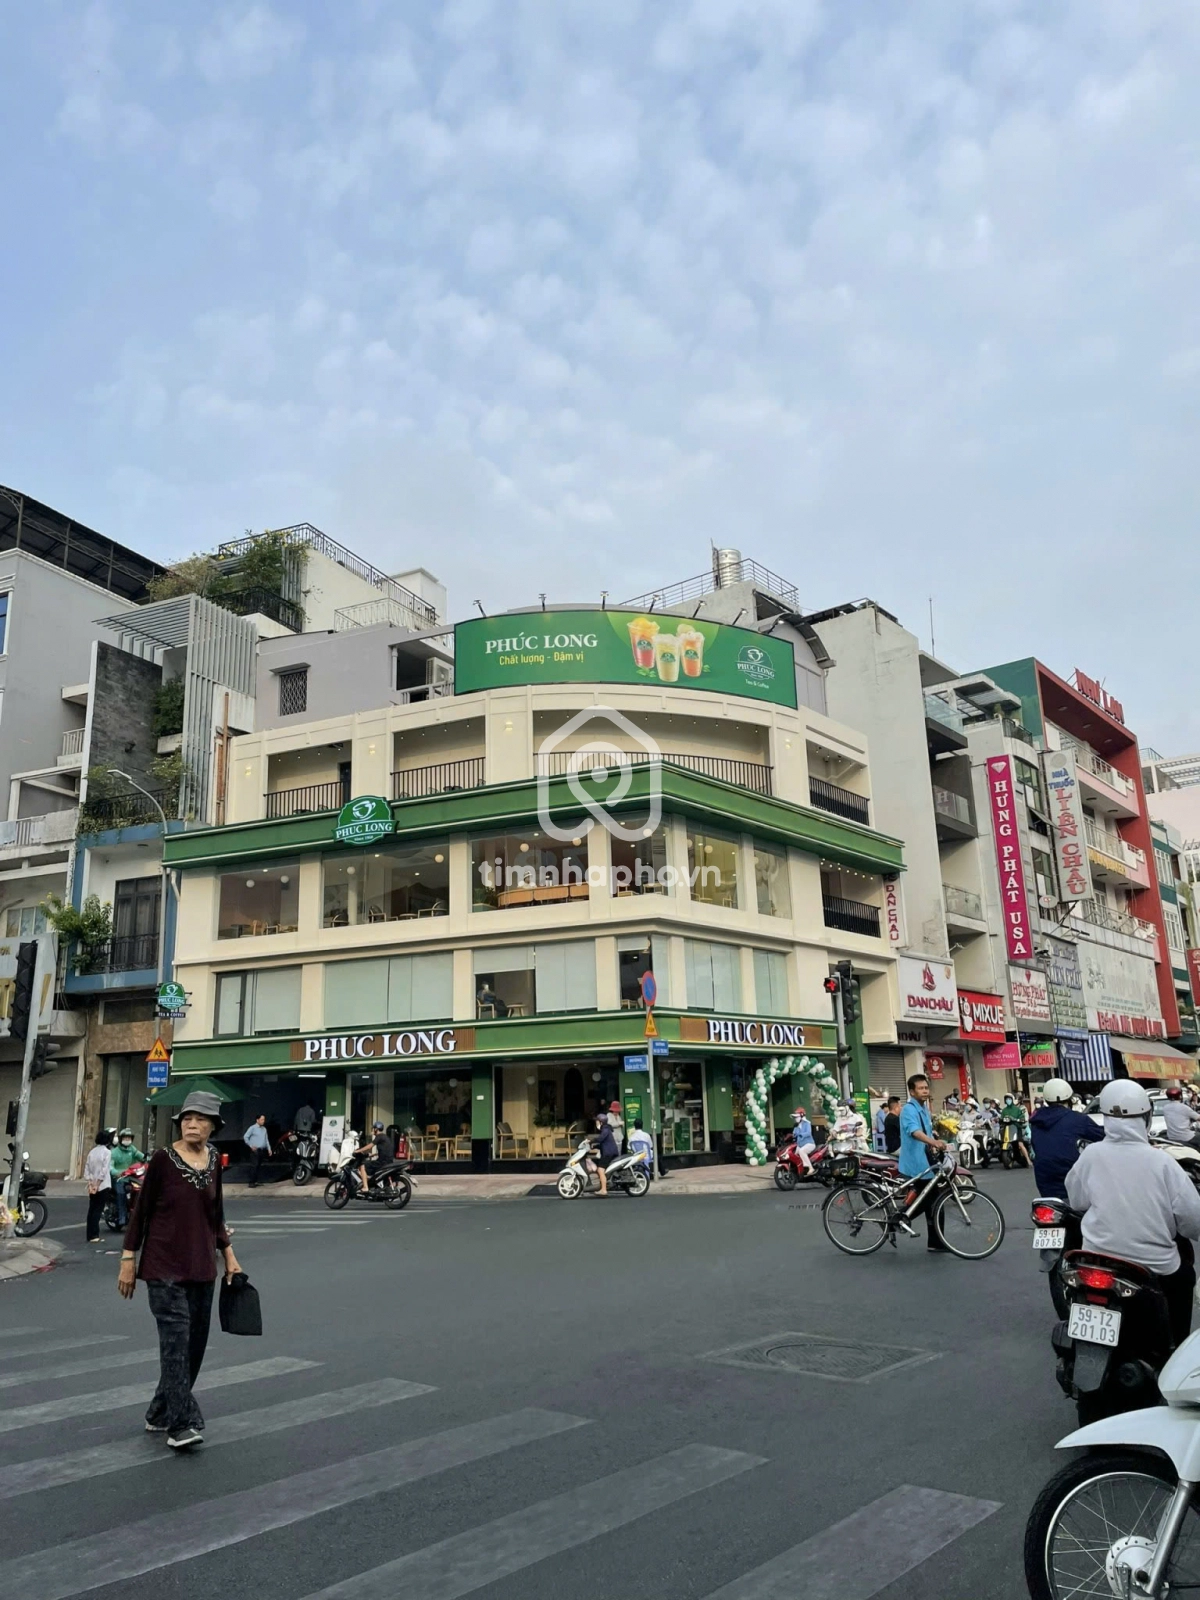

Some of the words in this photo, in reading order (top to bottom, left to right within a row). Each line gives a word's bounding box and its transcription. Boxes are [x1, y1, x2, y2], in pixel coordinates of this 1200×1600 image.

[485, 631, 539, 654] PHÚC
[543, 633, 598, 649] LONG
[499, 653, 518, 666] Chất
[521, 653, 545, 666] lượng
[553, 651, 573, 664] Đậm
[576, 651, 584, 663] vị
[757, 666, 775, 678] LONG
[994, 780, 1012, 837] HƯNG
[1054, 787, 1079, 839] LIÊN
[364, 822, 393, 833] LONG
[1003, 845, 1019, 903] PHÁT
[1062, 842, 1088, 895] CHÂU
[1010, 911, 1027, 955] USA
[972, 1001, 1005, 1026] MIXUE
[304, 1035, 375, 1061] PHUC
[381, 1029, 457, 1056] LONG
[706, 1019, 758, 1044] PHUC
[760, 1023, 805, 1047] LONG
[1038, 1229, 1060, 1238] 59-C1
[1078, 1307, 1113, 1327] 59-T2
[1071, 1321, 1116, 1343] 201.03
